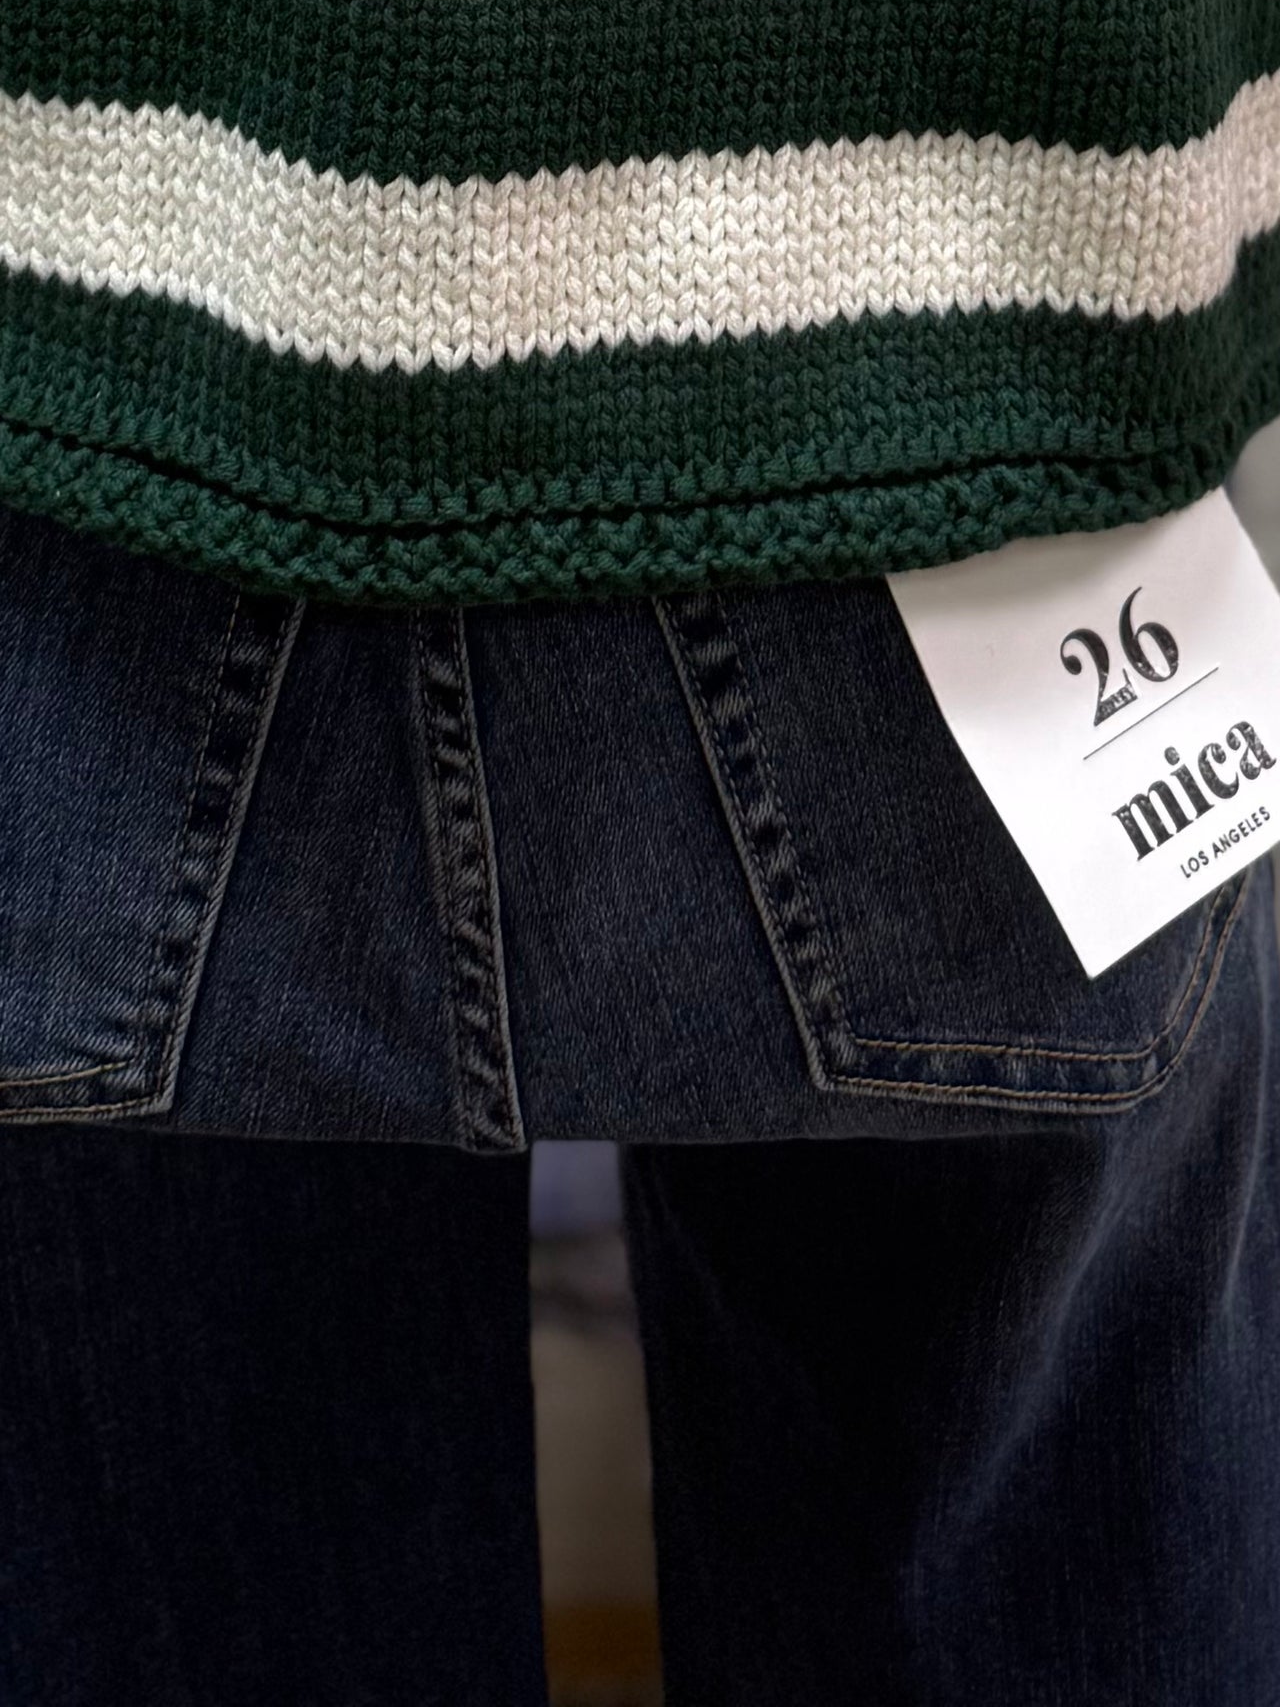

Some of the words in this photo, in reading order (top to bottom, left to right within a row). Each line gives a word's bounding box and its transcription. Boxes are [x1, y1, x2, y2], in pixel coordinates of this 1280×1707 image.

[1060, 586, 1179, 727] 26
[1111, 721, 1277, 862] mica
[1180, 850, 1209, 879] LOS
[1212, 806, 1271, 859] ANGELES
